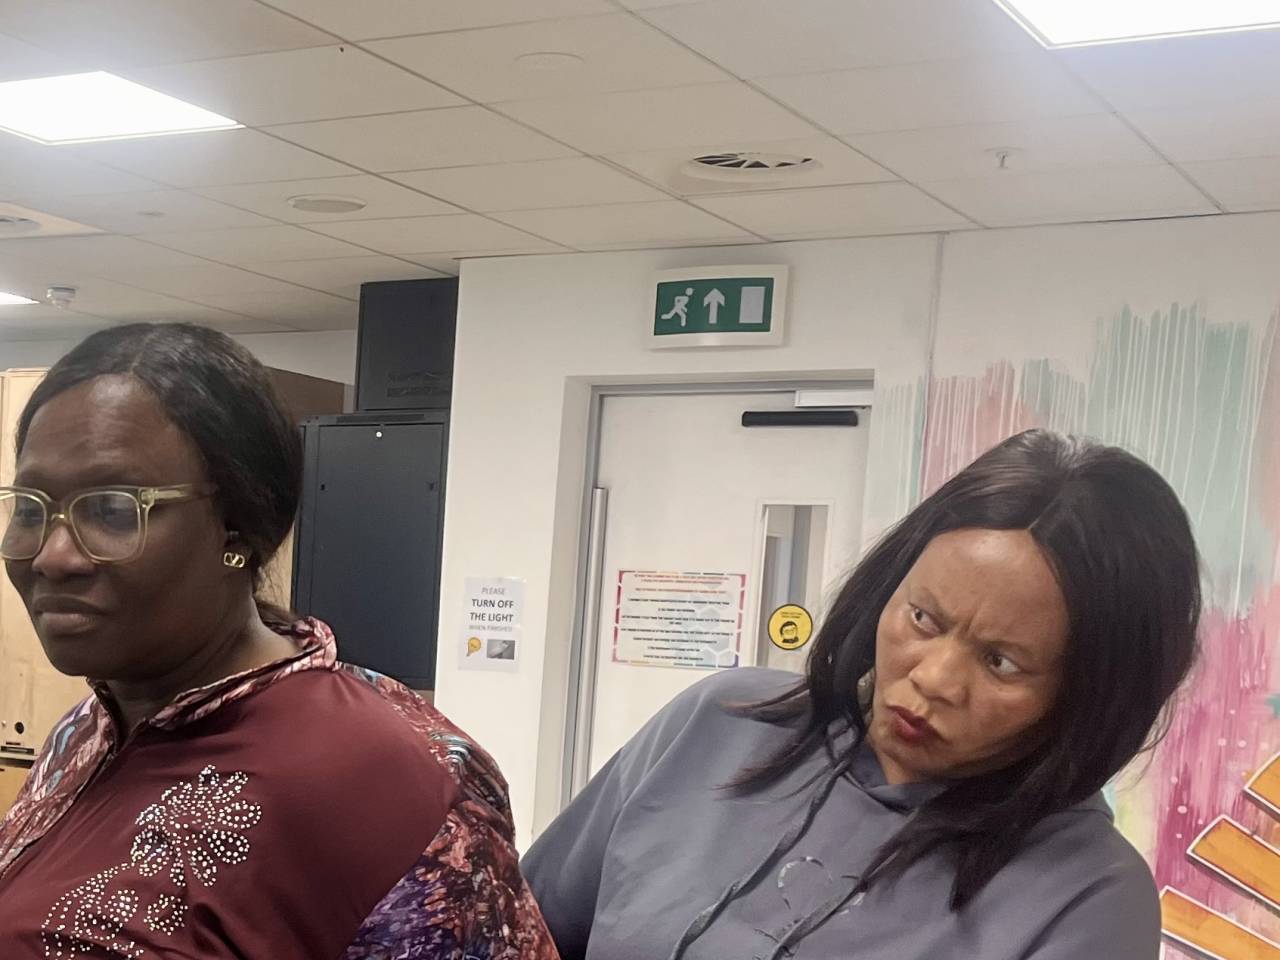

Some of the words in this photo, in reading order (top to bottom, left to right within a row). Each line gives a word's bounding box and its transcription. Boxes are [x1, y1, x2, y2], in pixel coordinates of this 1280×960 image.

[481, 587, 505, 595] PLEASE
[472, 599, 495, 607] TURN
[497, 600, 514, 608] OFF
[470, 612, 486, 621] THE
[488, 613, 514, 622] LIGHT
